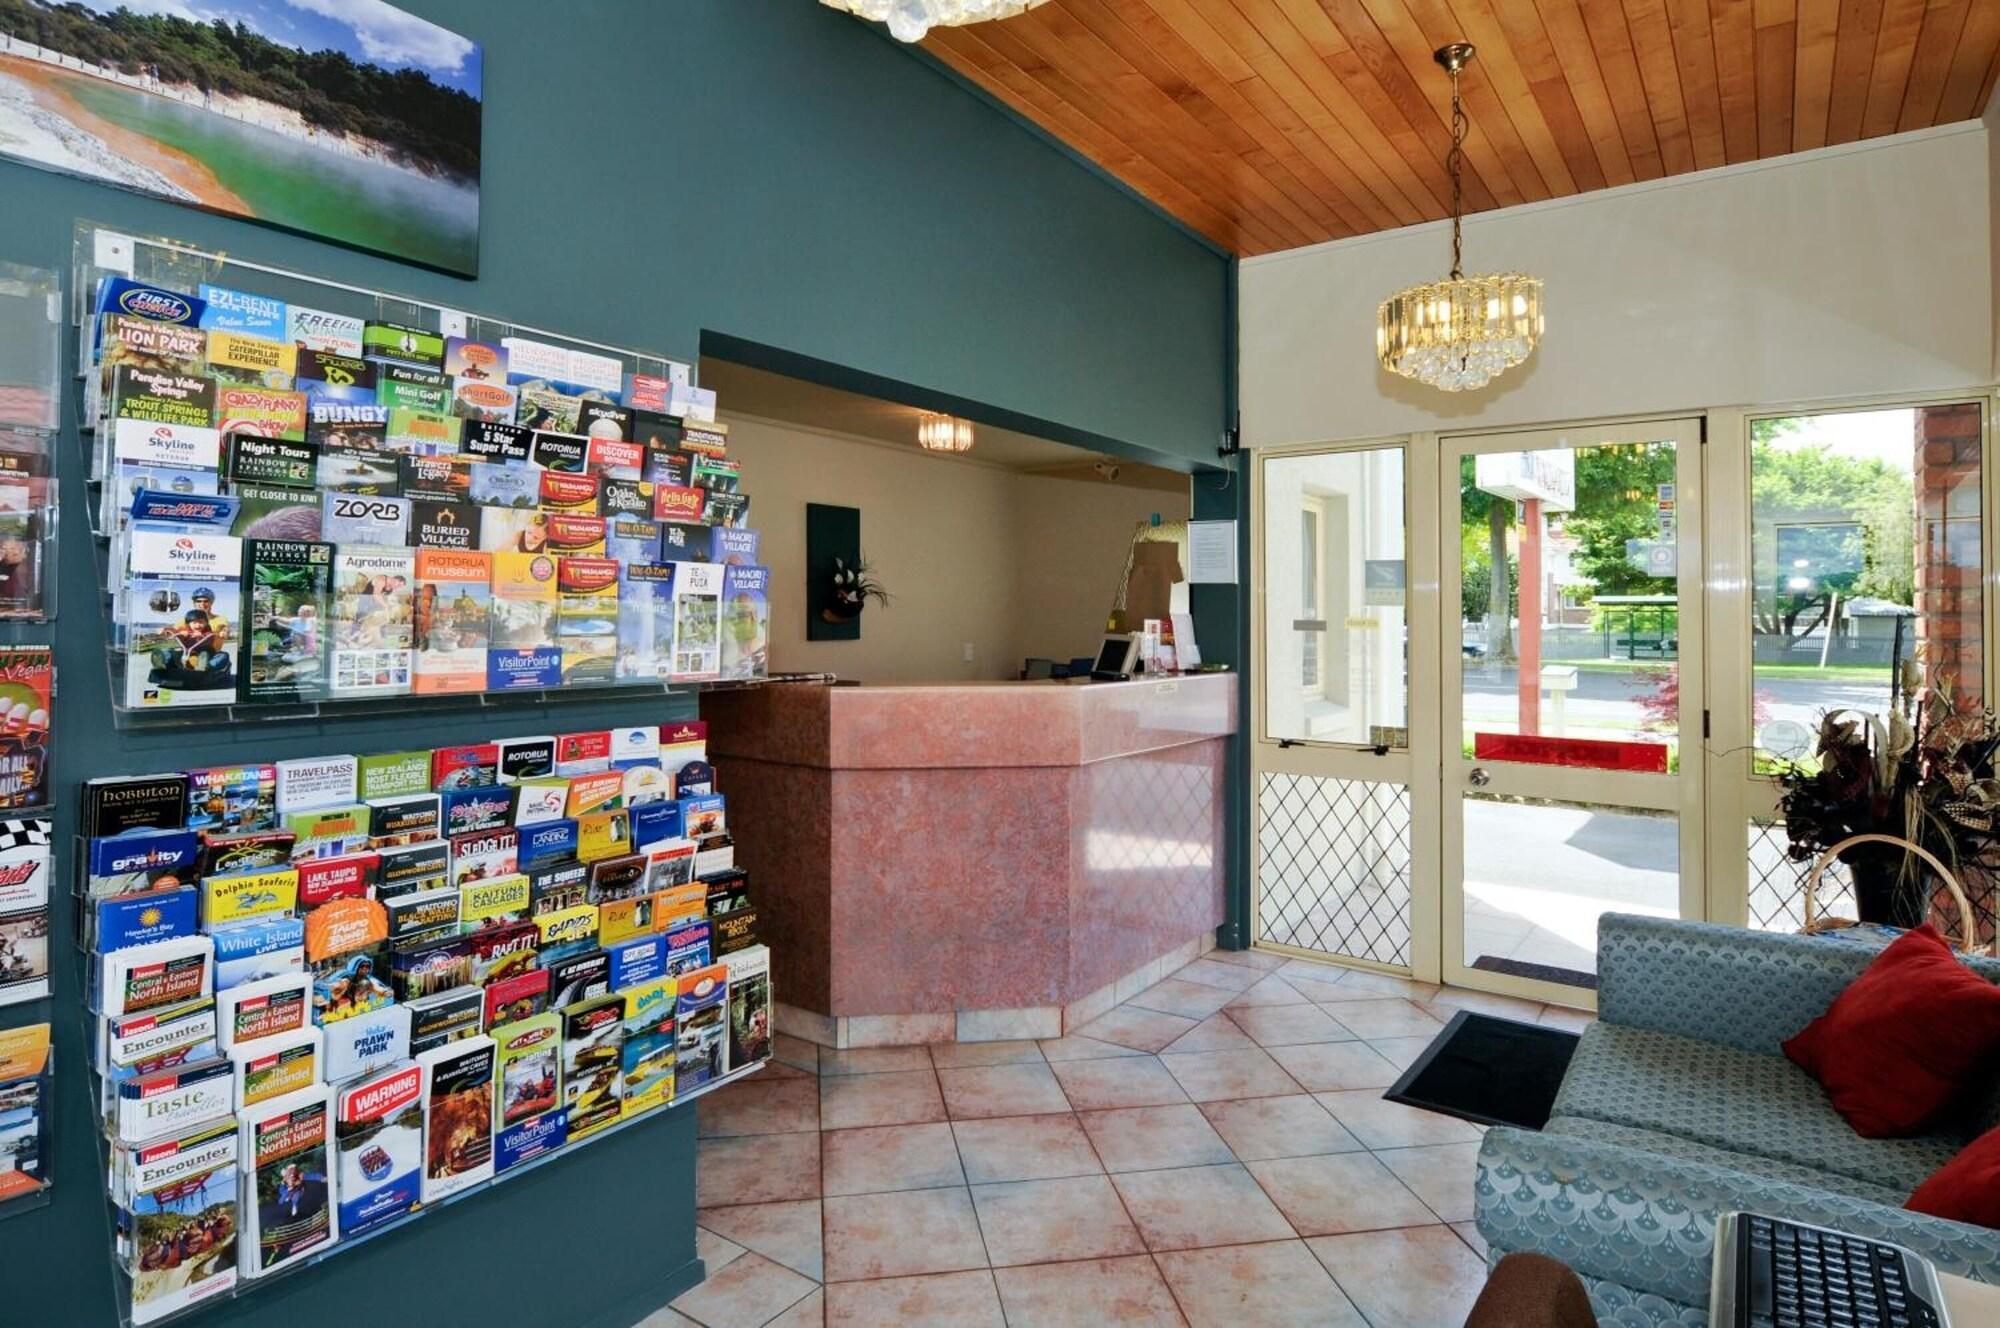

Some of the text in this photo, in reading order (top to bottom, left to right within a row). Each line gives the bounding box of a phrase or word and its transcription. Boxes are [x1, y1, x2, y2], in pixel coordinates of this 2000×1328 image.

[137, 292, 182, 306] FIRST
[119, 327, 200, 353] LION PARK
[228, 352, 279, 367] EXPERIENCE
[229, 344, 280, 359] CATERPILLAR
[129, 369, 205, 393] Paradise Valley
[392, 368, 412, 379] Fun
[413, 371, 427, 382] for
[427, 374, 440, 384] all
[150, 383, 188, 398] Springs
[395, 386, 442, 402] Mini Golf
[126, 399, 163, 412] TROUT
[163, 403, 208, 417] SPRINGS
[313, 405, 387, 424] BUNGY
[120, 408, 208, 427] & WILDLIFE PARK
[149, 437, 196, 452] Skyline
[483, 431, 515, 446] 5 Star
[241, 441, 311, 459] Night Tours
[469, 439, 526, 457] Super Pass
[540, 442, 581, 455] ROTORUA
[596, 445, 640, 459] DISCOVER
[239, 456, 288, 467] RAINBOW
[417, 468, 450, 481] Legacy
[243, 488, 317, 503] GET CLOSER TO KIWI
[334, 499, 400, 520] ZORB
[422, 524, 470, 536] BURIED
[256, 541, 308, 552] RAINBOW
[420, 534, 469, 546] VILLAGE
[724, 542, 754, 553] VILLAGE
[169, 548, 216, 562] Skyline
[256, 551, 308, 559] SPRINGS
[346, 556, 407, 569] Agrodome
[428, 556, 485, 567] ROTORUA
[426, 566, 486, 578] museum
[733, 579, 761, 590] VILLAGE
[498, 654, 551, 669] VisitorPoint
[507, 750, 549, 762] ROTORUA
[195, 769, 272, 787] WHAKATANE
[287, 763, 353, 779] TRAVELPASS
[112, 850, 183, 872] gravity
[308, 867, 358, 884] LAKE TAUPO
[538, 867, 586, 886] THE SQUEEZE
[215, 876, 296, 898] Dolphin Seafaris
[472, 884, 525, 899] KAITUNA
[471, 893, 525, 908] CASCADES
[159, 922, 175, 932] Bay
[221, 928, 303, 953] White Island
[492, 937, 519, 960] RAFT
[256, 943, 279, 955] LIVE
[130, 969, 200, 990] Central Eastern
[129, 977, 200, 1001] North Island
[239, 1002, 299, 1024] Central Eastern
[123, 1023, 155, 1037] Jasons
[238, 1012, 299, 1035] North Island
[122, 1021, 208, 1055] Encounter
[354, 1030, 394, 1050] PRAWN
[358, 1043, 389, 1059] PARK
[272, 1066, 289, 1079] The
[144, 1083, 175, 1098] Jasons
[248, 1070, 311, 1095] Coromandel
[355, 1074, 417, 1113] WARNING
[142, 1091, 205, 1118] Taste
[260, 1117, 321, 1145] Central Eastern
[503, 1118, 556, 1148] VisitorPoint
[260, 1125, 322, 1156] North Island
[142, 1146, 229, 1182] Encounter
[144, 1148, 178, 1164] Jasons
